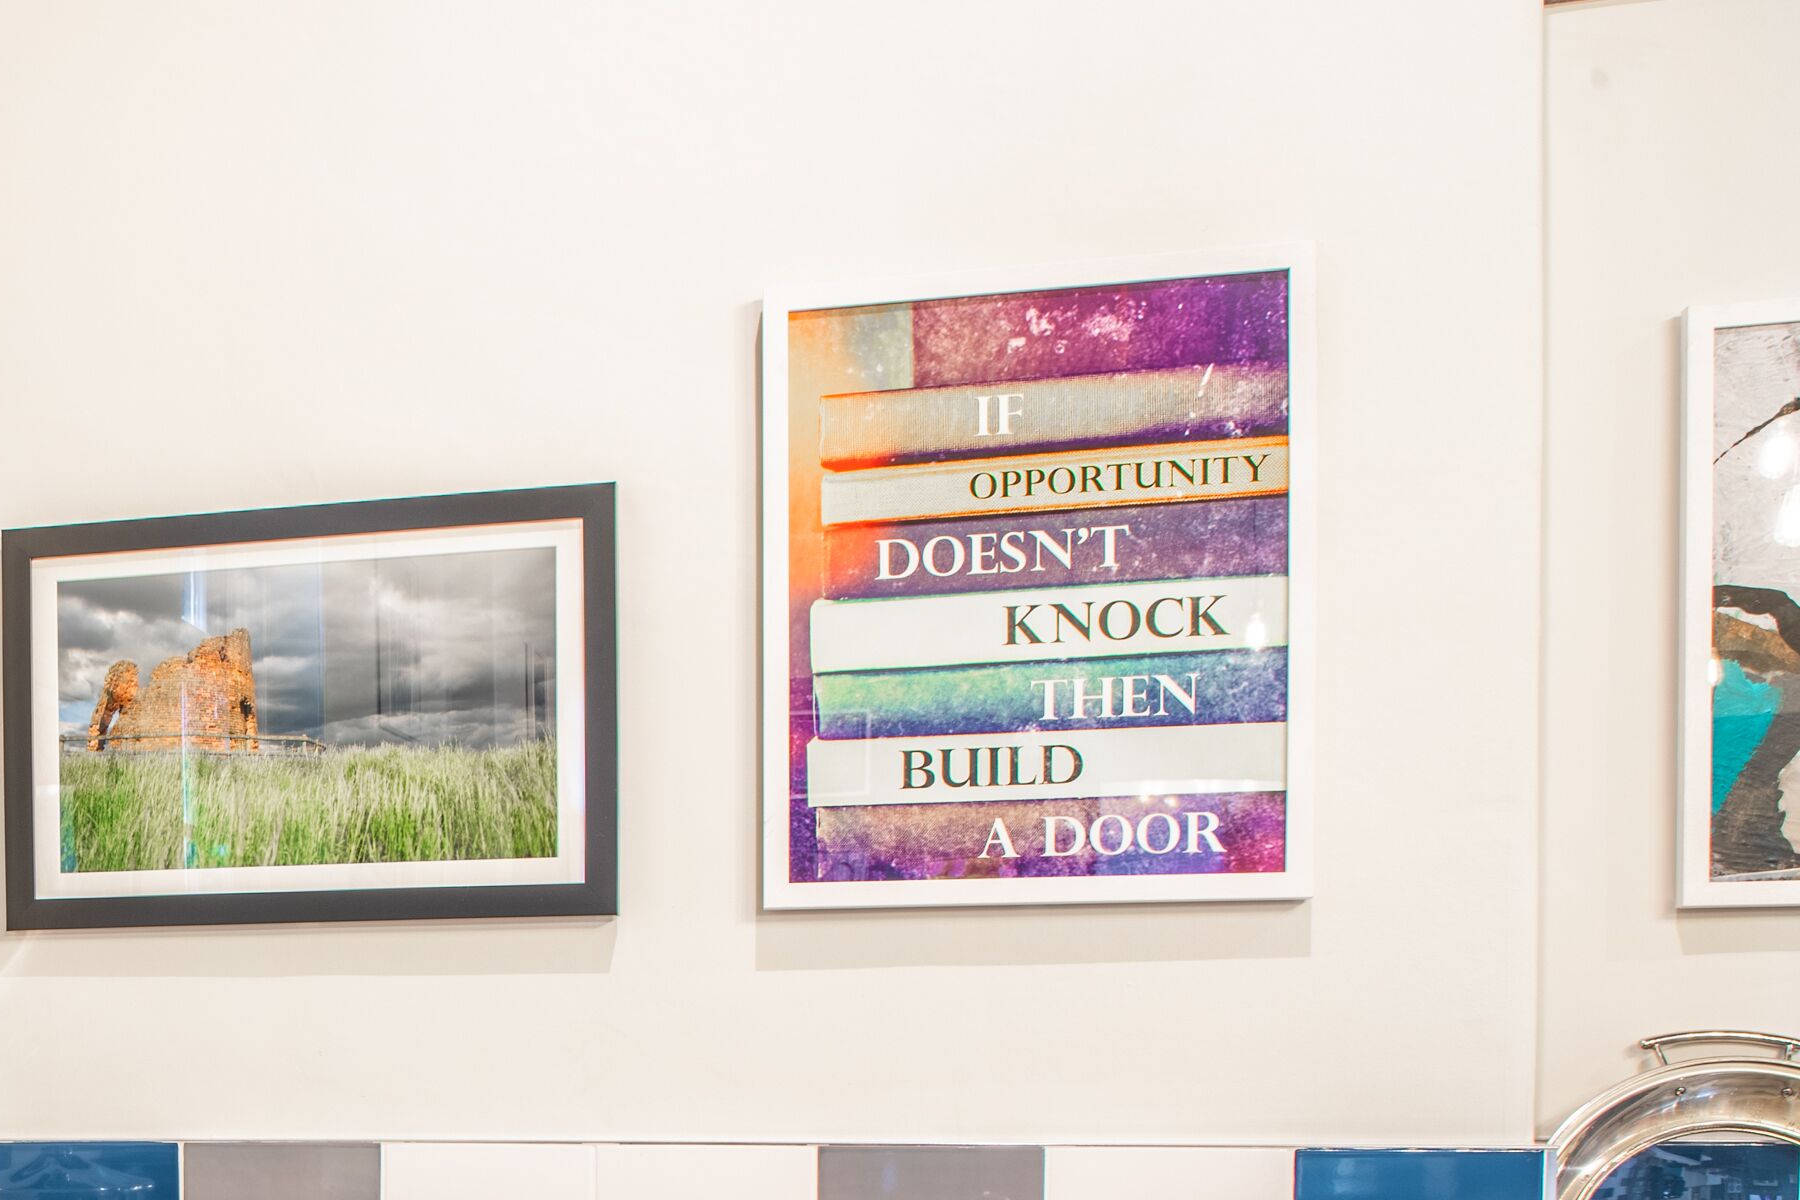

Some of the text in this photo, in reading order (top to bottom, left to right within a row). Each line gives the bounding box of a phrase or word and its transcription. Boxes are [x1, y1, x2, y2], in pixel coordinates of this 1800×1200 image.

[973, 393, 1025, 437] IF
[969, 453, 1271, 500] OPPORTUNITY
[874, 524, 1130, 581] DOESN'T
[1002, 594, 1231, 646] KNOCK
[1030, 672, 1200, 721] THEN
[898, 744, 1085, 790] BUILD
[977, 811, 1229, 860] A DOOR
